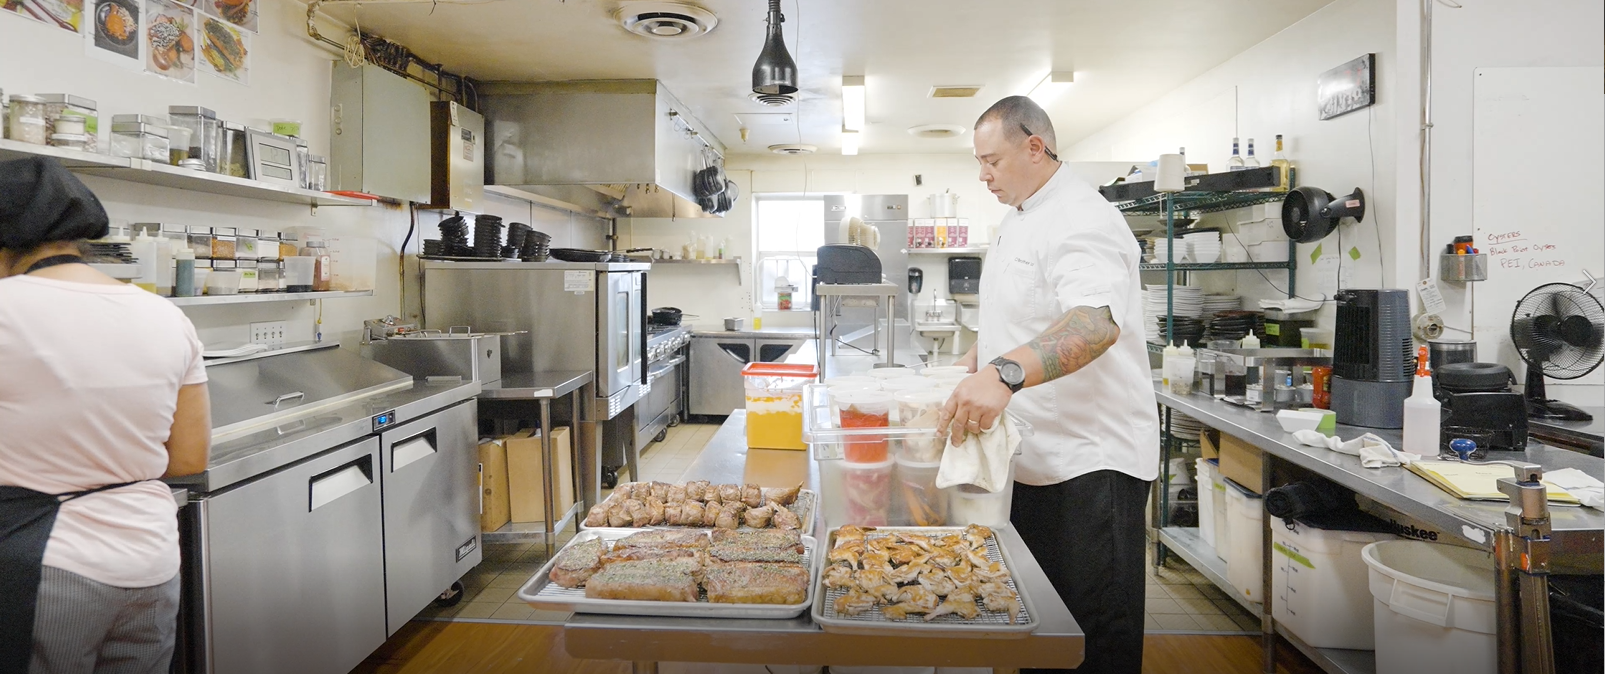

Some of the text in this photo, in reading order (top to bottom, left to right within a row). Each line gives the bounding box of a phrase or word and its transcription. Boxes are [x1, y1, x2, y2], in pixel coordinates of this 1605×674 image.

[1487, 231, 1521, 244] OYSTERS
[1489, 247, 1508, 256] Black
[1511, 245, 1529, 253] Point
[1500, 258, 1525, 270] PEI,
